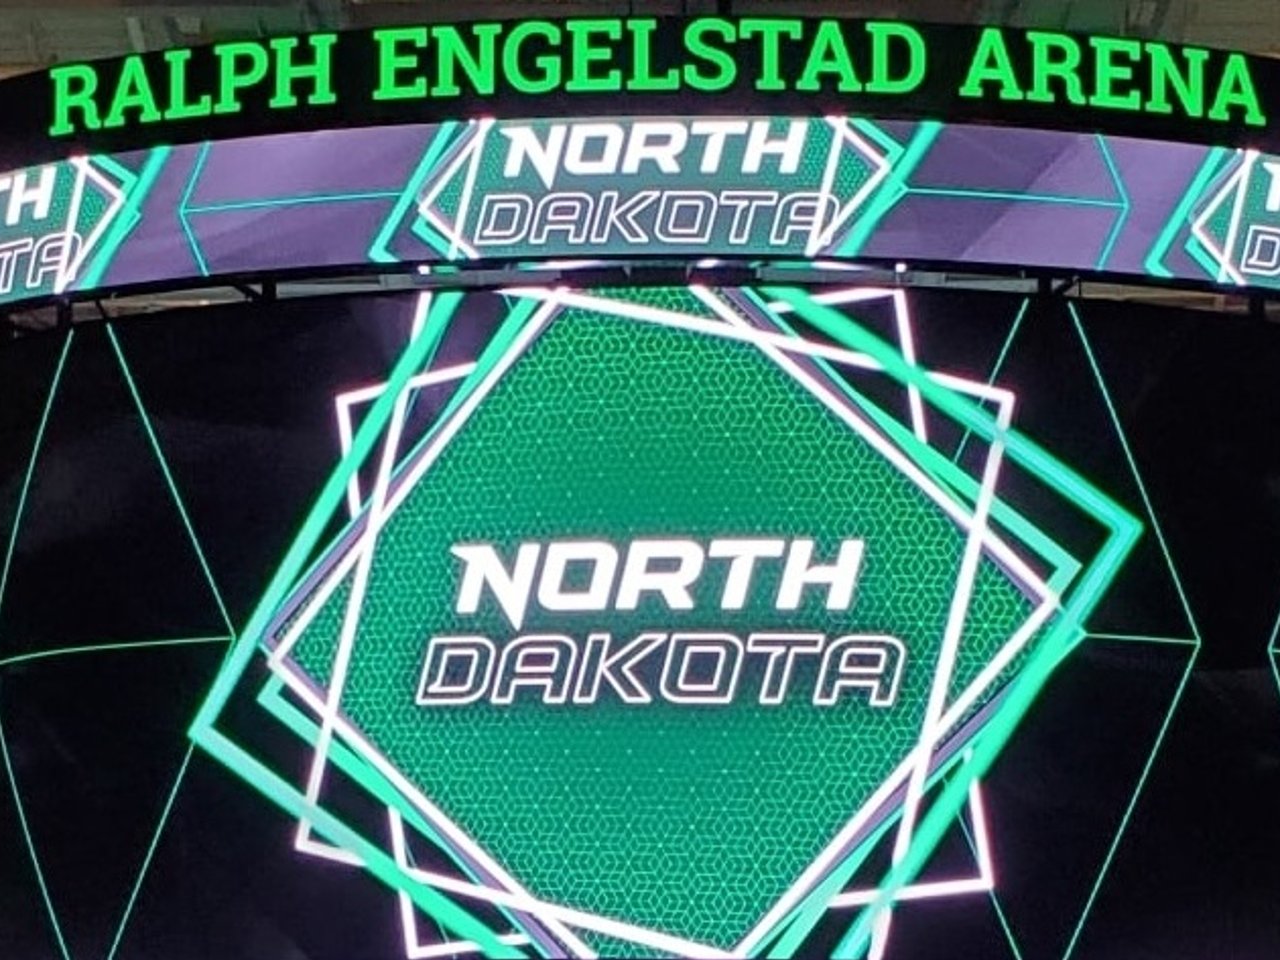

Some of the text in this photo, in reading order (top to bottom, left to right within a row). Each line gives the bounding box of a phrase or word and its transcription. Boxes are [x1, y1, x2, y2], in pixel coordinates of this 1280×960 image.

[48, 18, 1266, 136] RALPH ENGELSTAD ARENA
[500, 121, 797, 188] NORTH
[474, 190, 840, 246] DAKOTA
[449, 539, 865, 632] NORTH
[415, 633, 907, 707] DAKOTA
